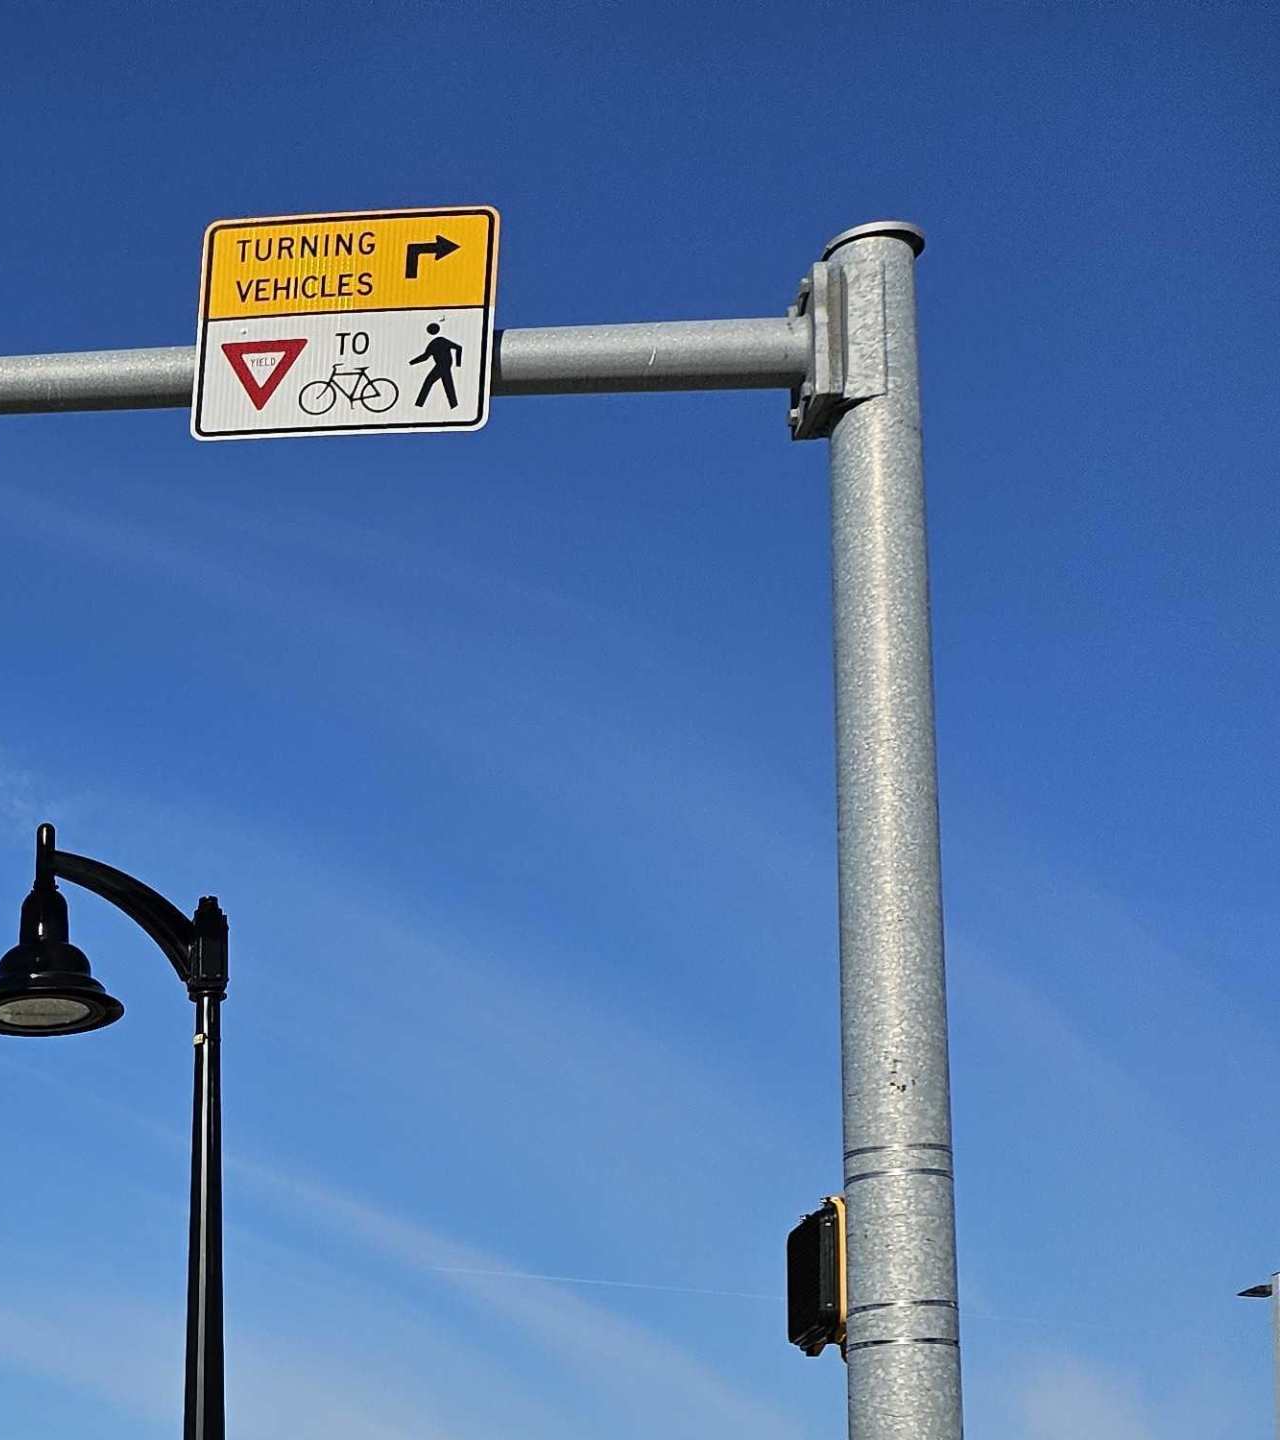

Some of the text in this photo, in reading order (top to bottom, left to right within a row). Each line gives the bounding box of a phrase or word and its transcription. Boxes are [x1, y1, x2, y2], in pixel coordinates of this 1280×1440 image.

[237, 231, 377, 264] TURNING
[235, 272, 374, 304] VEHICLES
[335, 331, 370, 356] TO
[249, 356, 278, 369] YIELD
